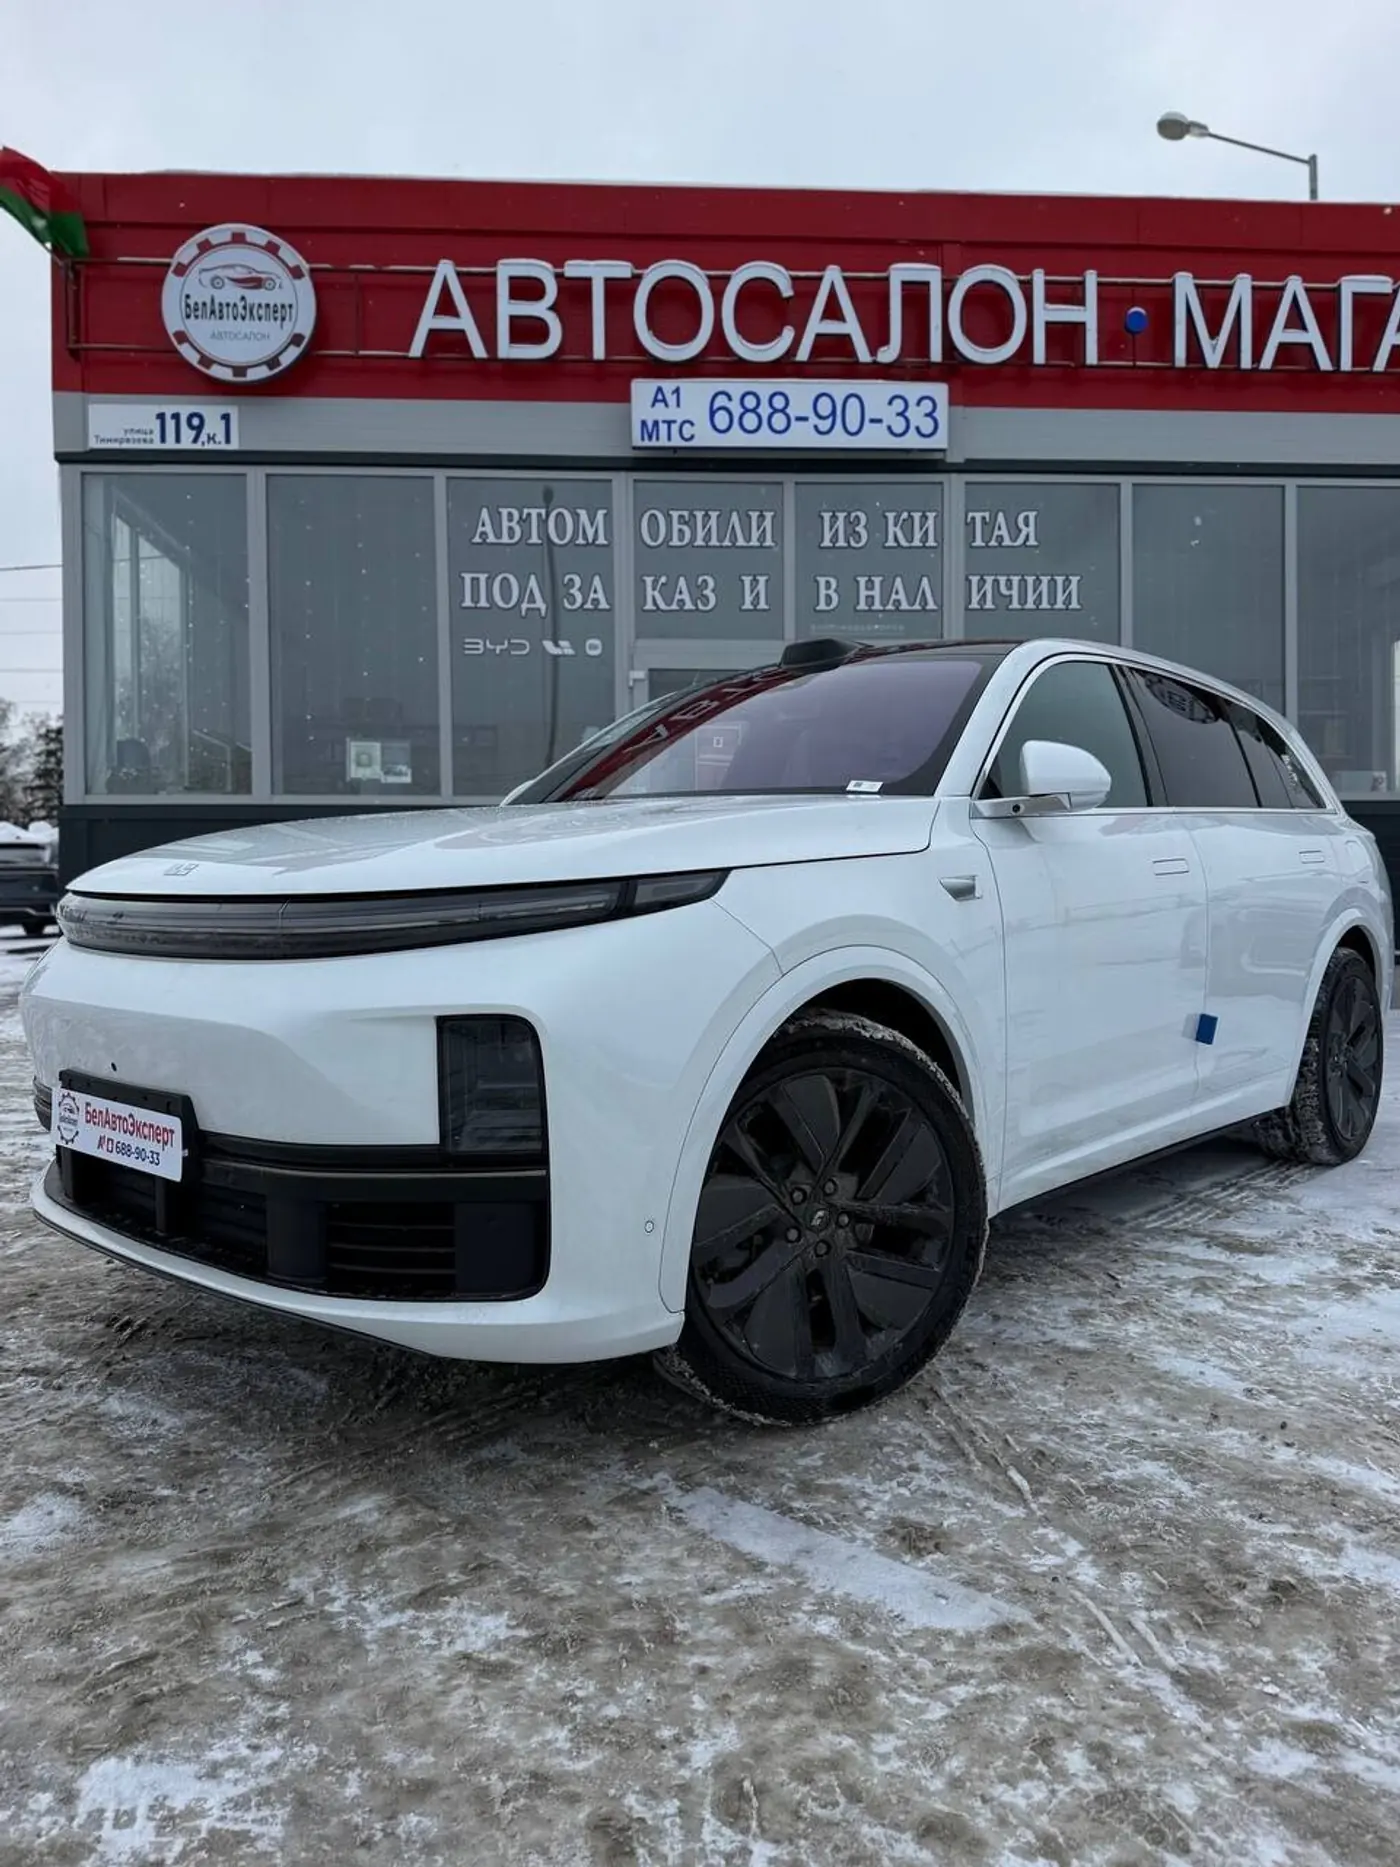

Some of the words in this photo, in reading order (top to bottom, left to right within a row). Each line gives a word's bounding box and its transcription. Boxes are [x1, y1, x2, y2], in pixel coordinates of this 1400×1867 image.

[184, 294, 294, 330] БелАвтоЭксперт
[409, 257, 1099, 366] АВТОСАЛОН
[210, 329, 271, 342] АВТОСАЛОН
[650, 386, 682, 408] A1
[708, 390, 940, 438] 688-90-33
[640, 419, 696, 443] МТС
[460, 573, 547, 618] ПОД
[740, 575, 770, 611] И
[815, 576, 840, 612] В
[84, 1101, 175, 1152] БелАвтоЭксперт
[115, 1140, 161, 1166] 688-90-33
